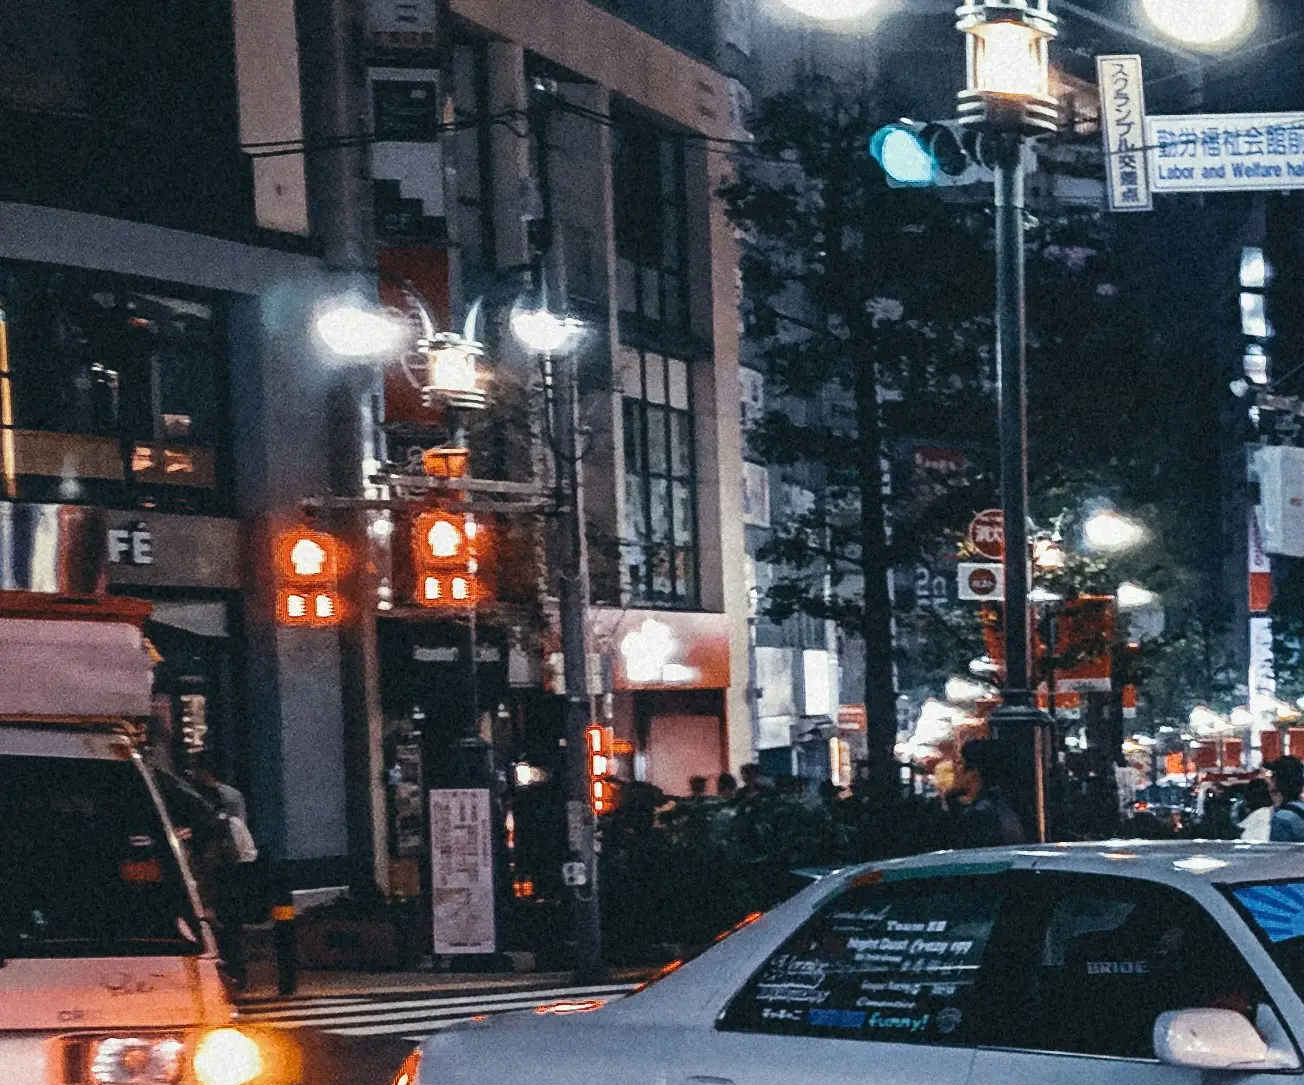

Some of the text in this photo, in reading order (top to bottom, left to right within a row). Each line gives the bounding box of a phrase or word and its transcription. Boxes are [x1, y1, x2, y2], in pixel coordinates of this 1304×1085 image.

[1157, 164, 1195, 181] Labor
[1201, 162, 1227, 180] and
[1230, 161, 1283, 179] Welfare
